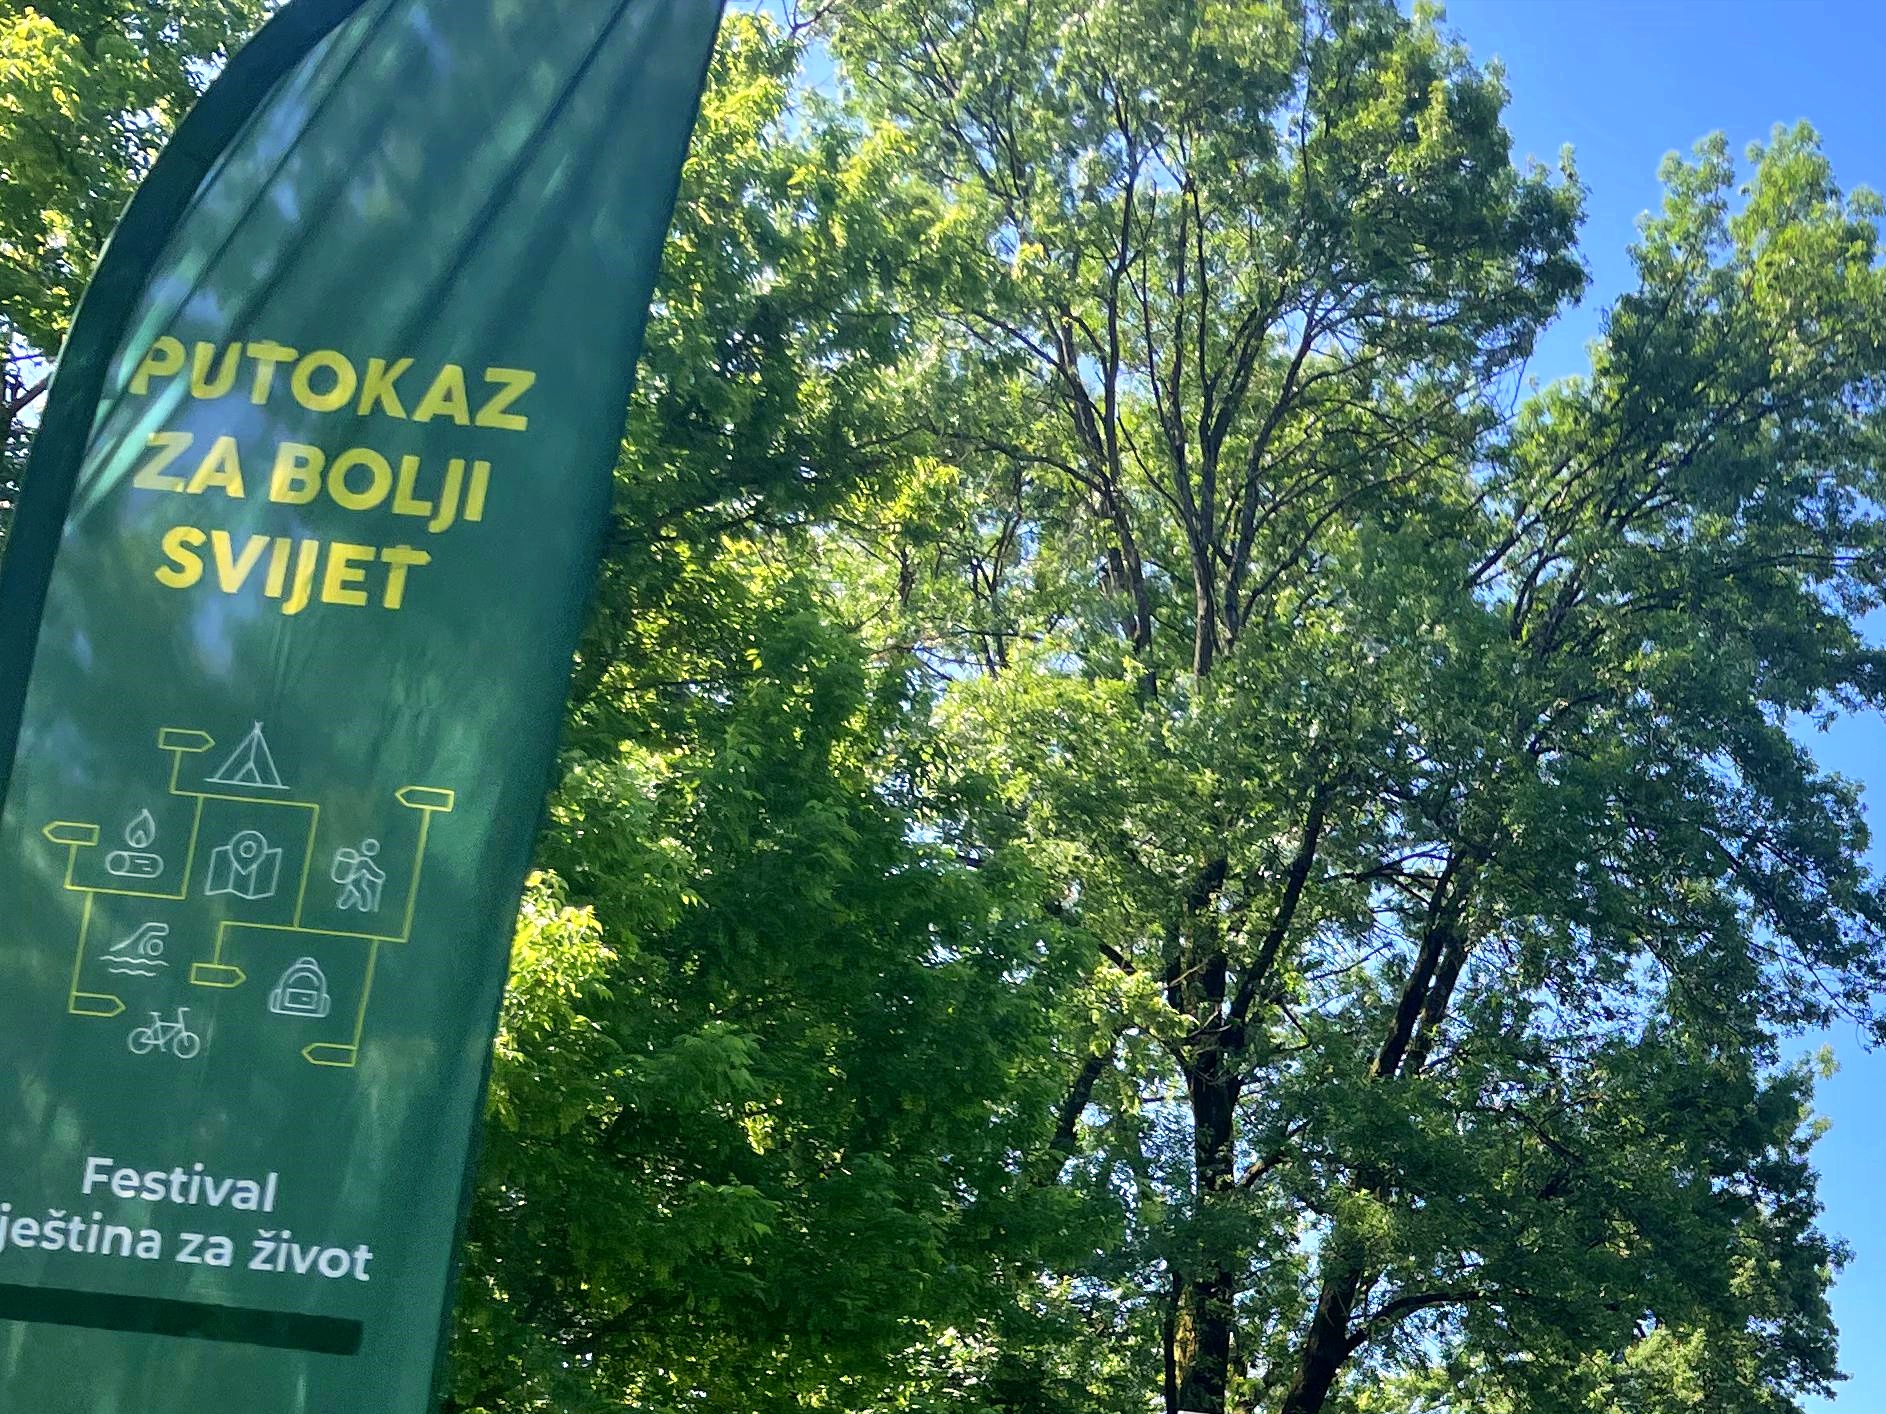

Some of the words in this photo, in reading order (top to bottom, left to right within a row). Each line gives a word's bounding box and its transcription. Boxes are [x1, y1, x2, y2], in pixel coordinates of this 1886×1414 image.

[128, 336, 536, 431] PUTOKAZ
[133, 433, 246, 498] ZA
[269, 441, 491, 533] BOLJI
[154, 526, 431, 615] SVIJET
[81, 1156, 279, 1213] Festival
[0, 1204, 162, 1260] ještina
[175, 1231, 234, 1268] za
[248, 1229, 374, 1281] život
